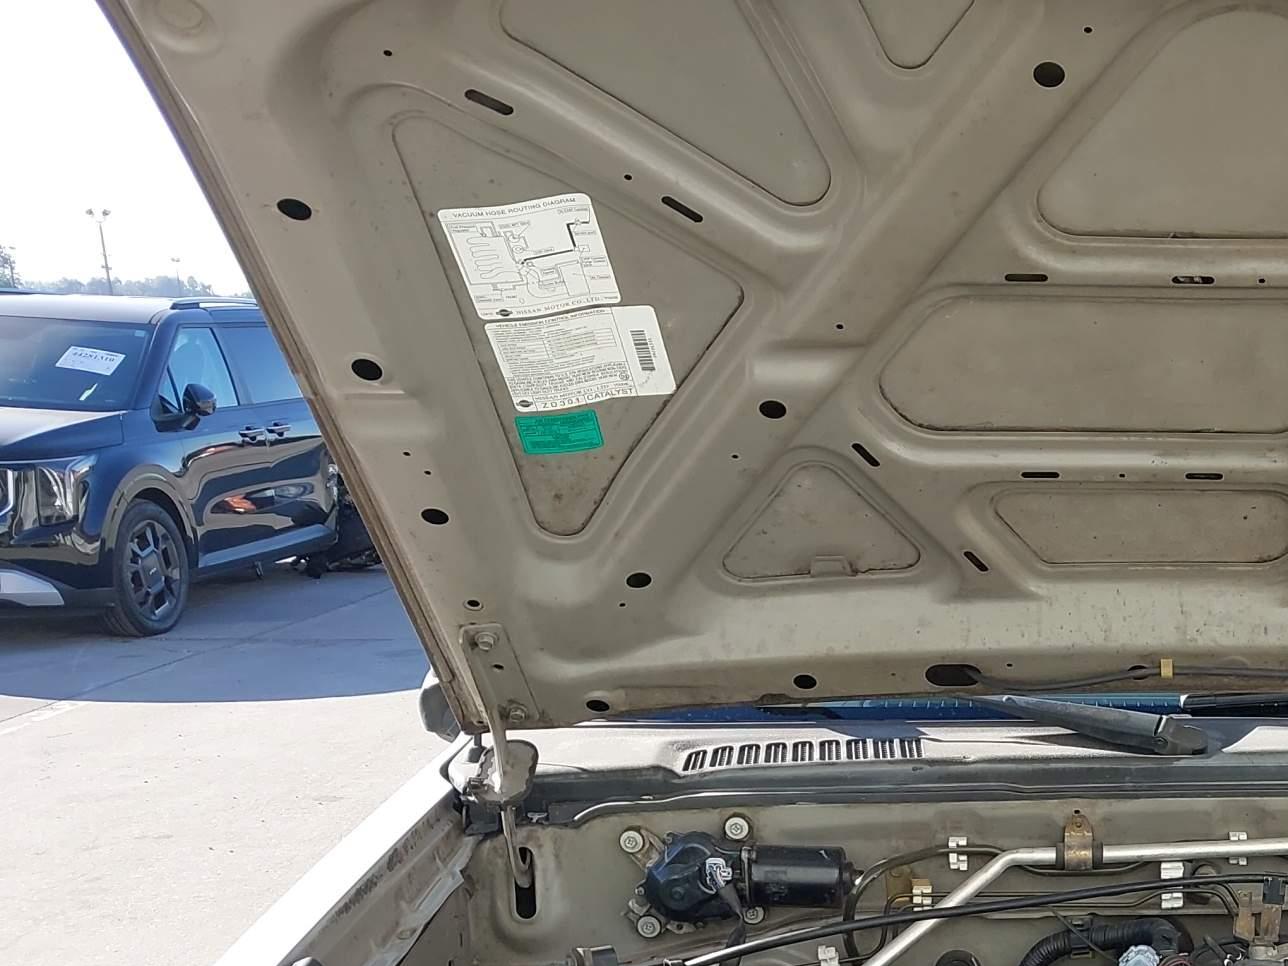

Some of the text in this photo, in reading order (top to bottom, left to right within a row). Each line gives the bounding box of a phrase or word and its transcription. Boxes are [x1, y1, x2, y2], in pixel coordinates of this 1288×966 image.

[453, 197, 577, 219] VACUUM HOSE ROUTING DIAGRAM
[586, 388, 633, 400] CATALYST
